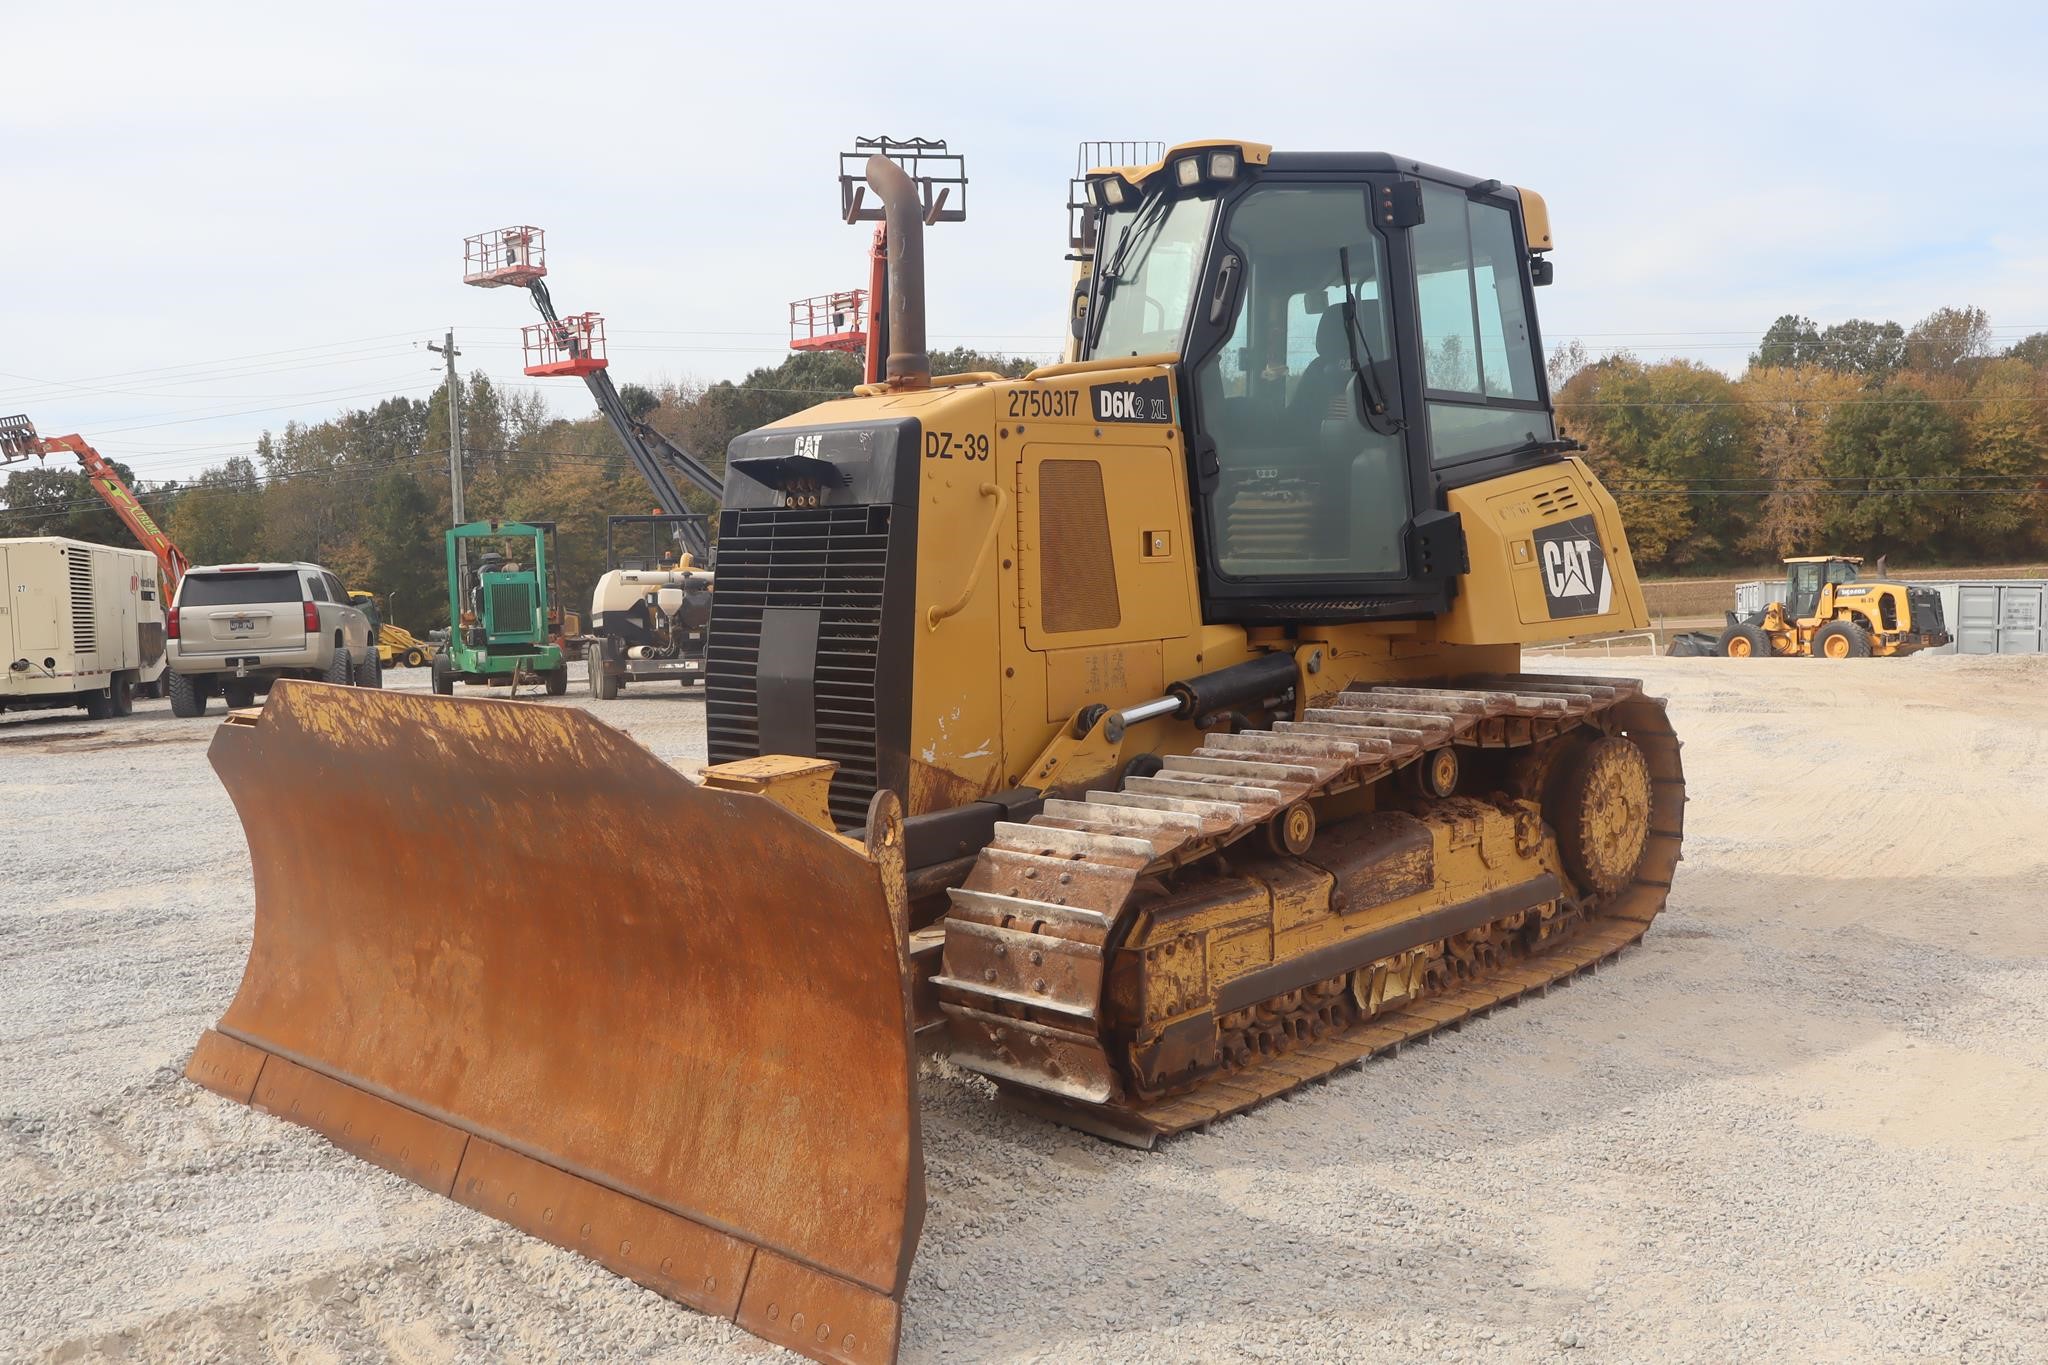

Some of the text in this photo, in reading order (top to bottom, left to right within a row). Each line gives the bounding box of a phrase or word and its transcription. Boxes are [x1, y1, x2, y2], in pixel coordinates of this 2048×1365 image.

[1008, 390, 1079, 417] 2750317
[1151, 399, 1168, 420] XL
[794, 434, 823, 459] CAT
[925, 431, 989, 461] DZ-39
[1543, 540, 1596, 598] CAT
[17, 585, 26, 593] 27
